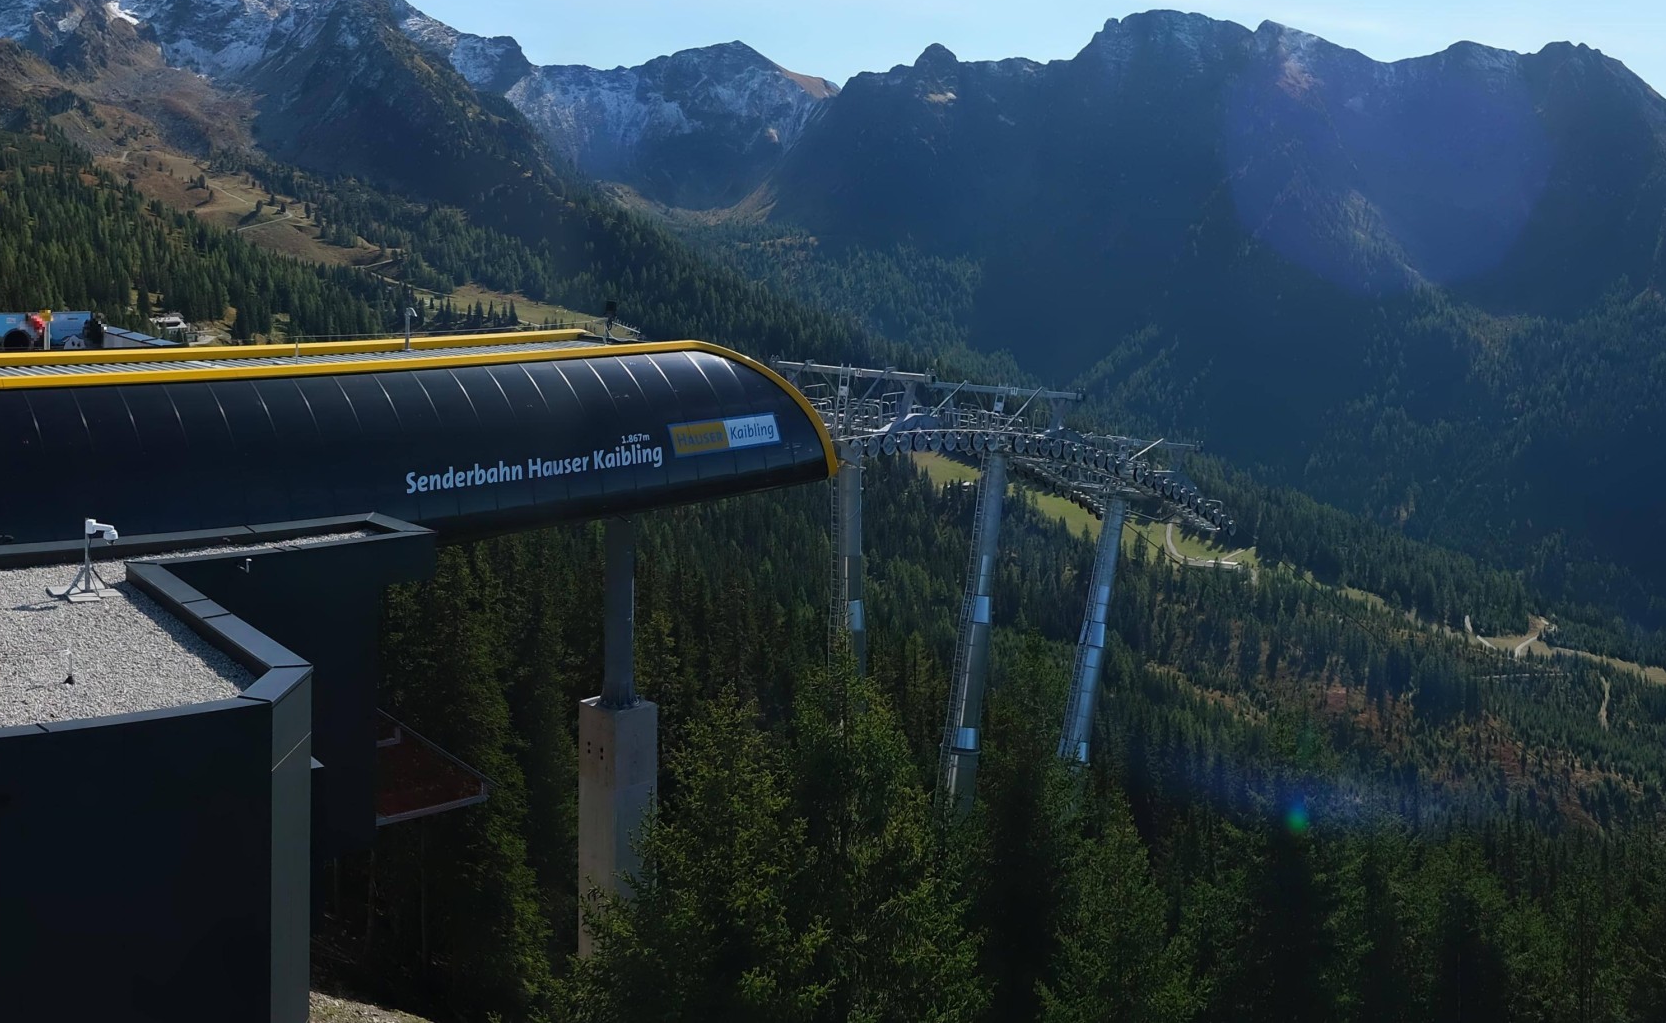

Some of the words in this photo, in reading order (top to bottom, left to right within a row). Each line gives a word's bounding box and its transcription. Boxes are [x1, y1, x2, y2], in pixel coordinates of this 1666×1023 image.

[621, 433, 651, 445] 1.867m
[676, 430, 724, 448] HAUSER
[729, 423, 774, 441] Kaibling
[405, 461, 523, 494] Senderbahn
[527, 453, 589, 479] Hauser
[593, 443, 663, 469] Kaibling
